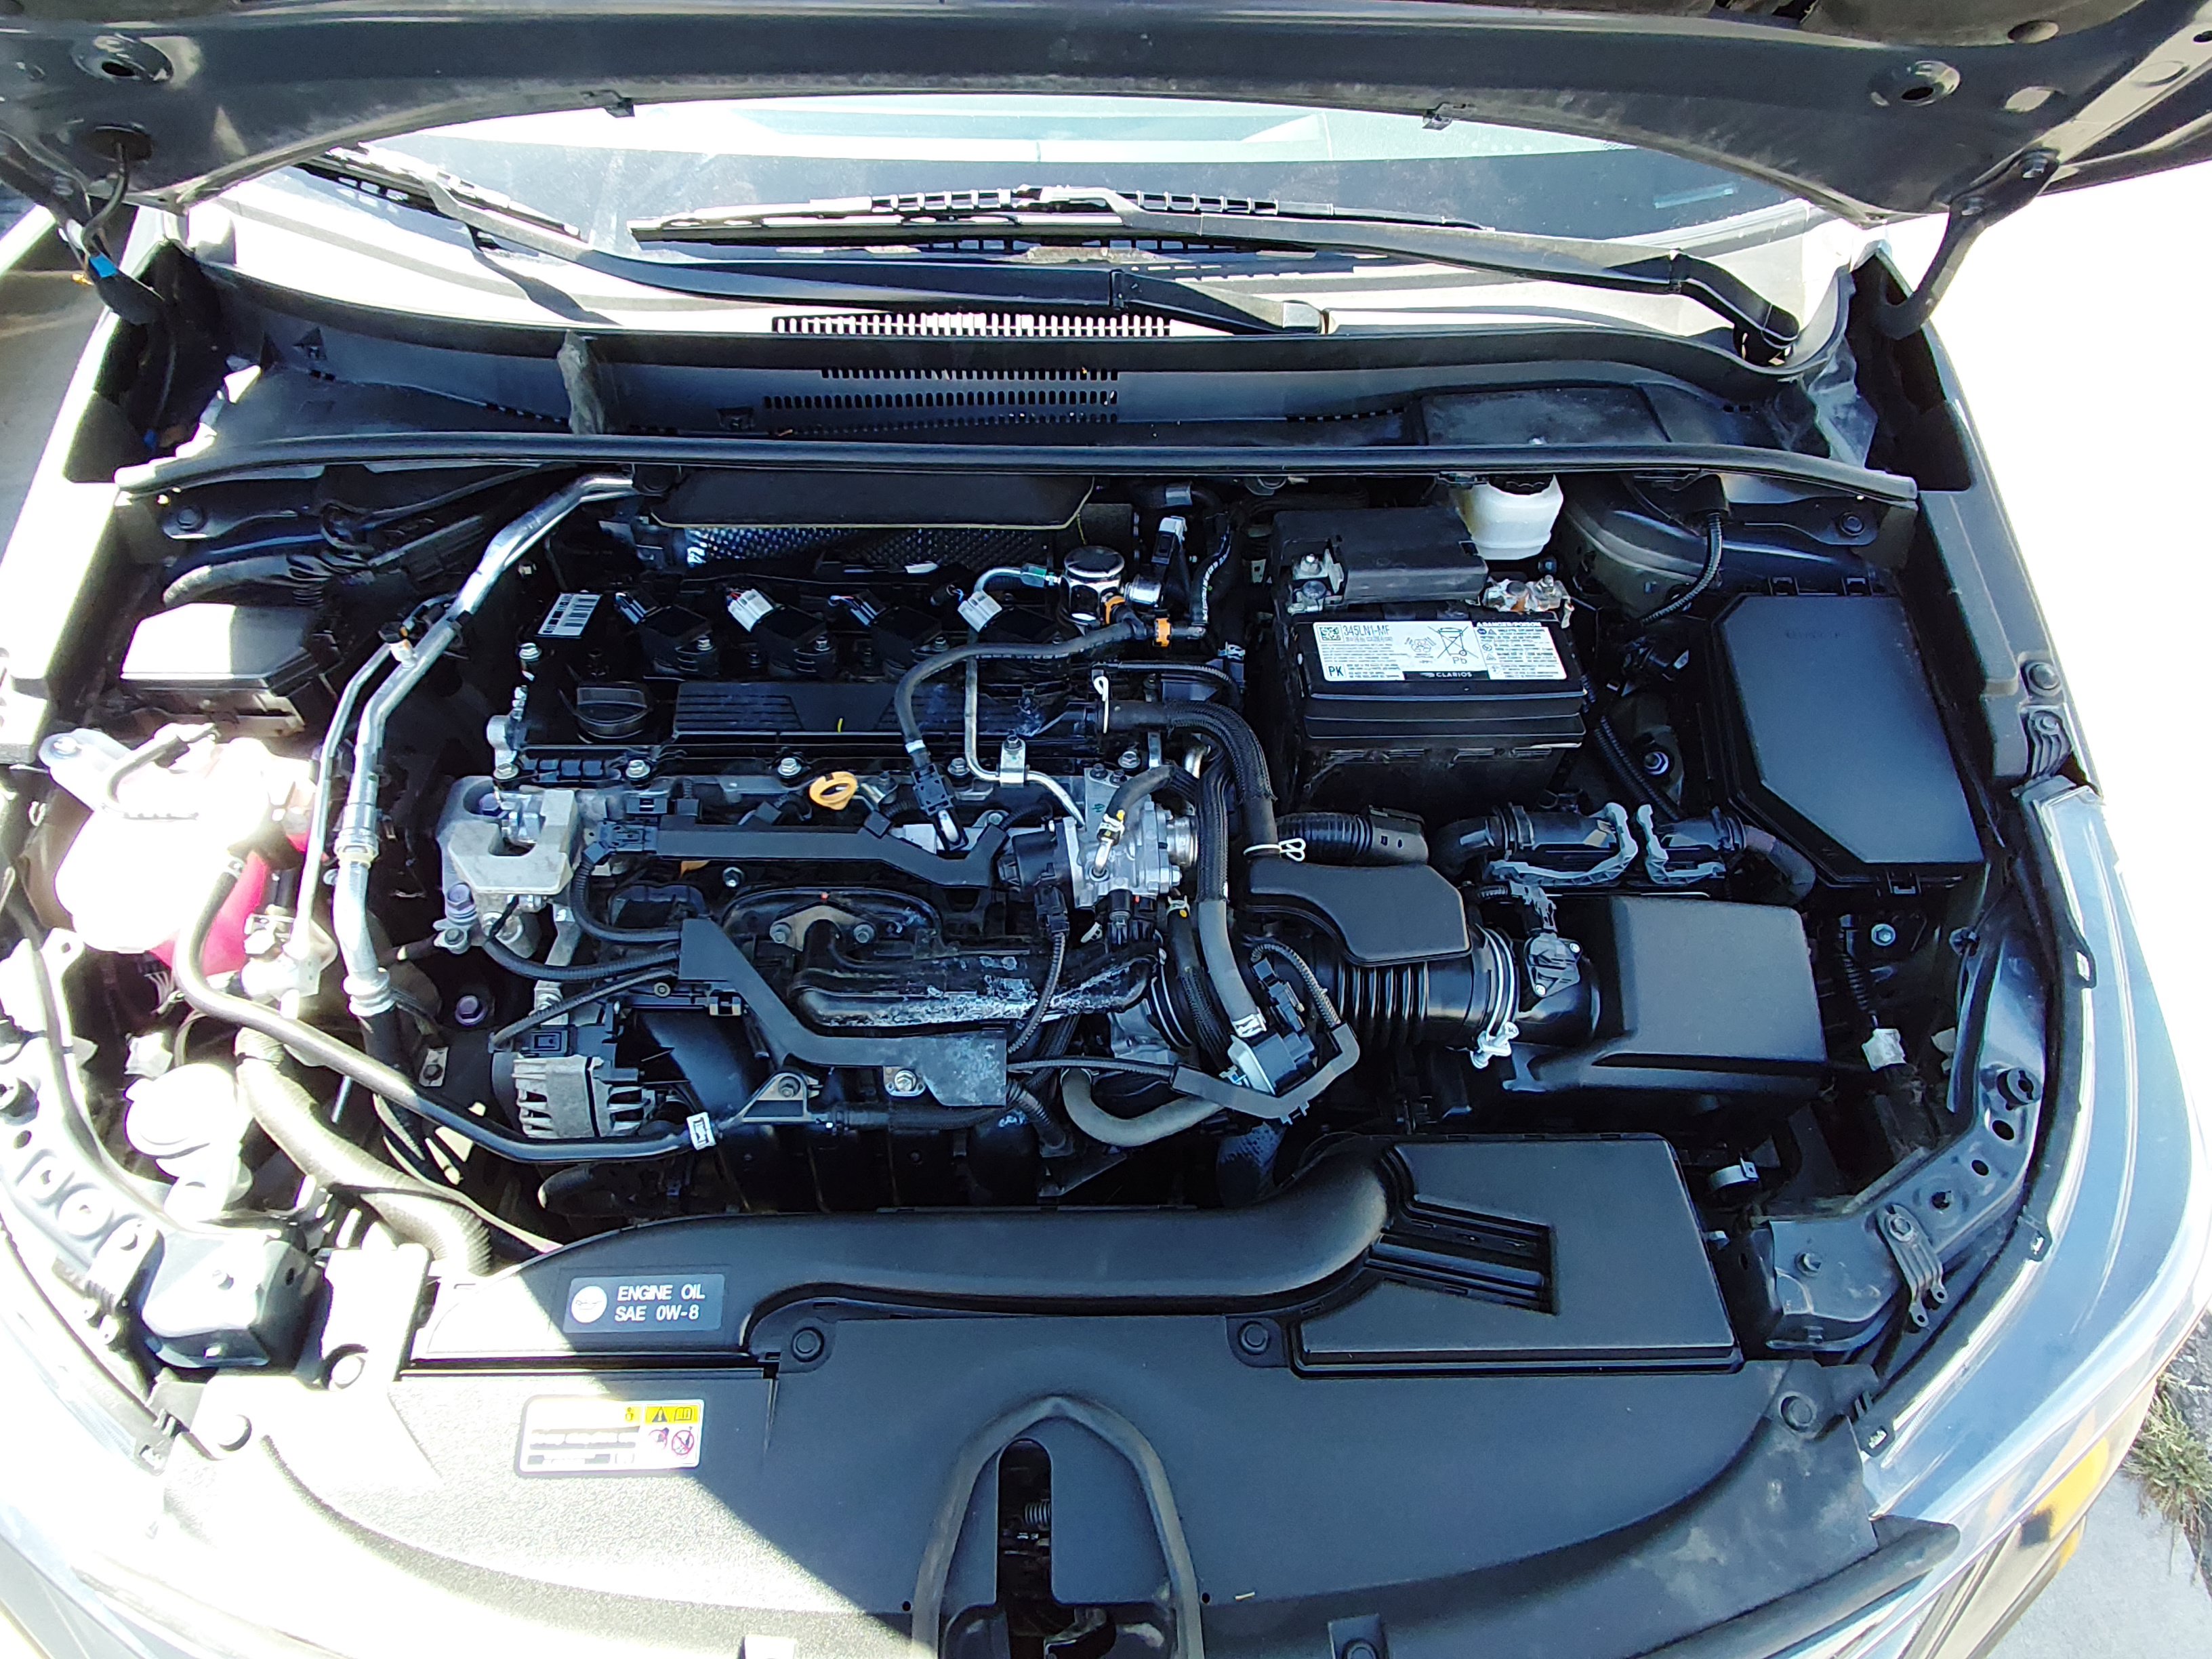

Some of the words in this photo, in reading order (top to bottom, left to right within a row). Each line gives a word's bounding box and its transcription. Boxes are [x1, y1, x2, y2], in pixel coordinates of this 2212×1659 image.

[1343, 625, 1390, 636] 345LN1-MF
[1328, 665, 1344, 677] PK
[617, 1284, 674, 1301] ENGINE
[681, 1284, 705, 1300] OIL
[615, 1305, 647, 1322] SAE
[656, 1304, 699, 1321] 0W-8
